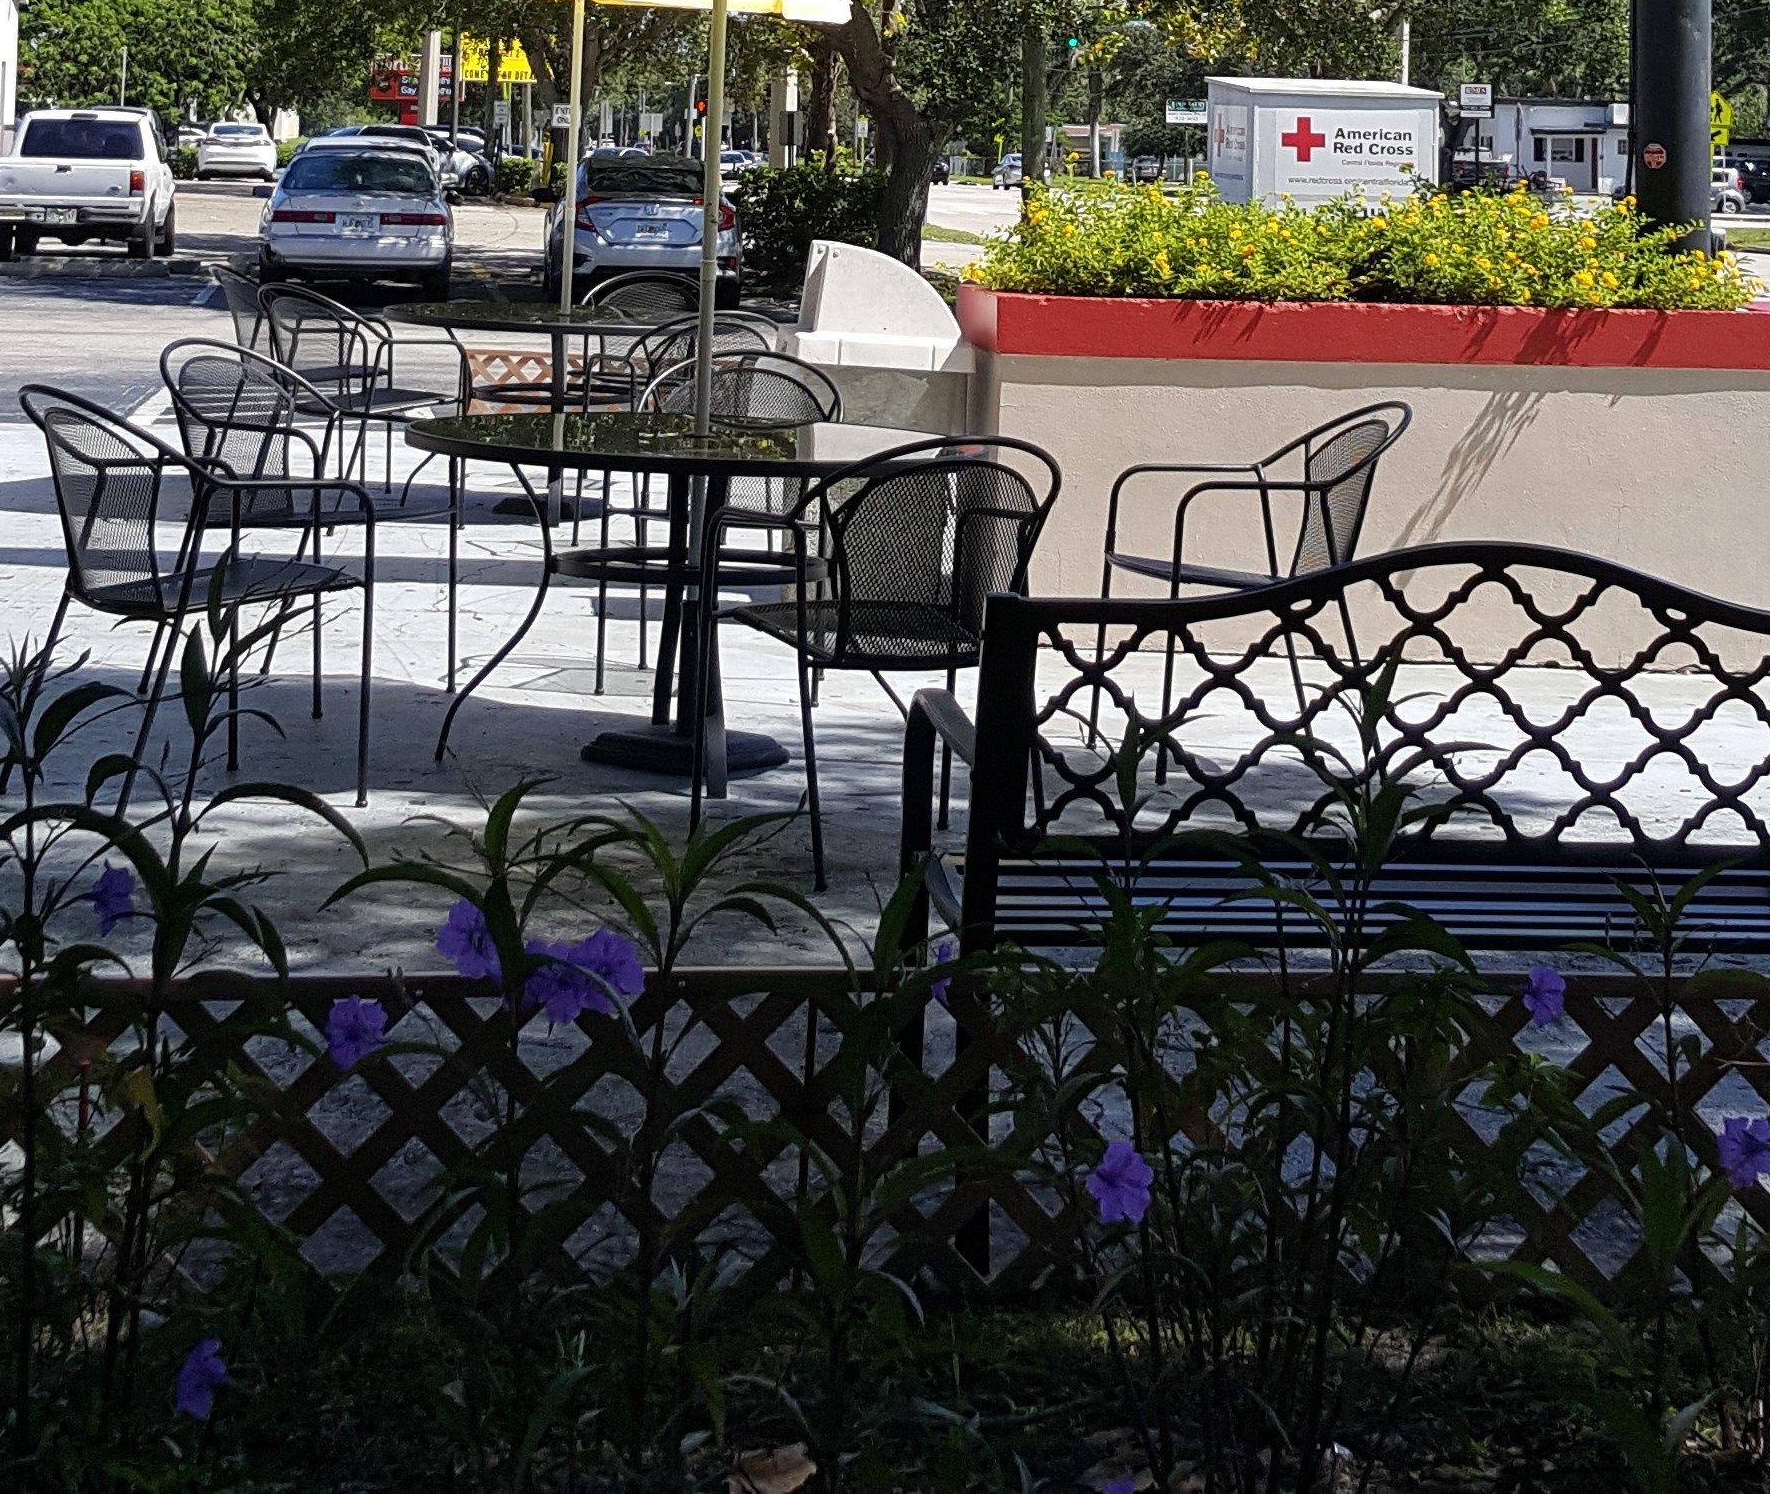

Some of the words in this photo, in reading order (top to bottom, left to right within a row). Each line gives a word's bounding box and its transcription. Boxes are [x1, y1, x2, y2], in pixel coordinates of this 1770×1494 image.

[1334, 127, 1412, 141] American
[1333, 141, 1363, 154] Red
[1369, 143, 1414, 156] Cross
